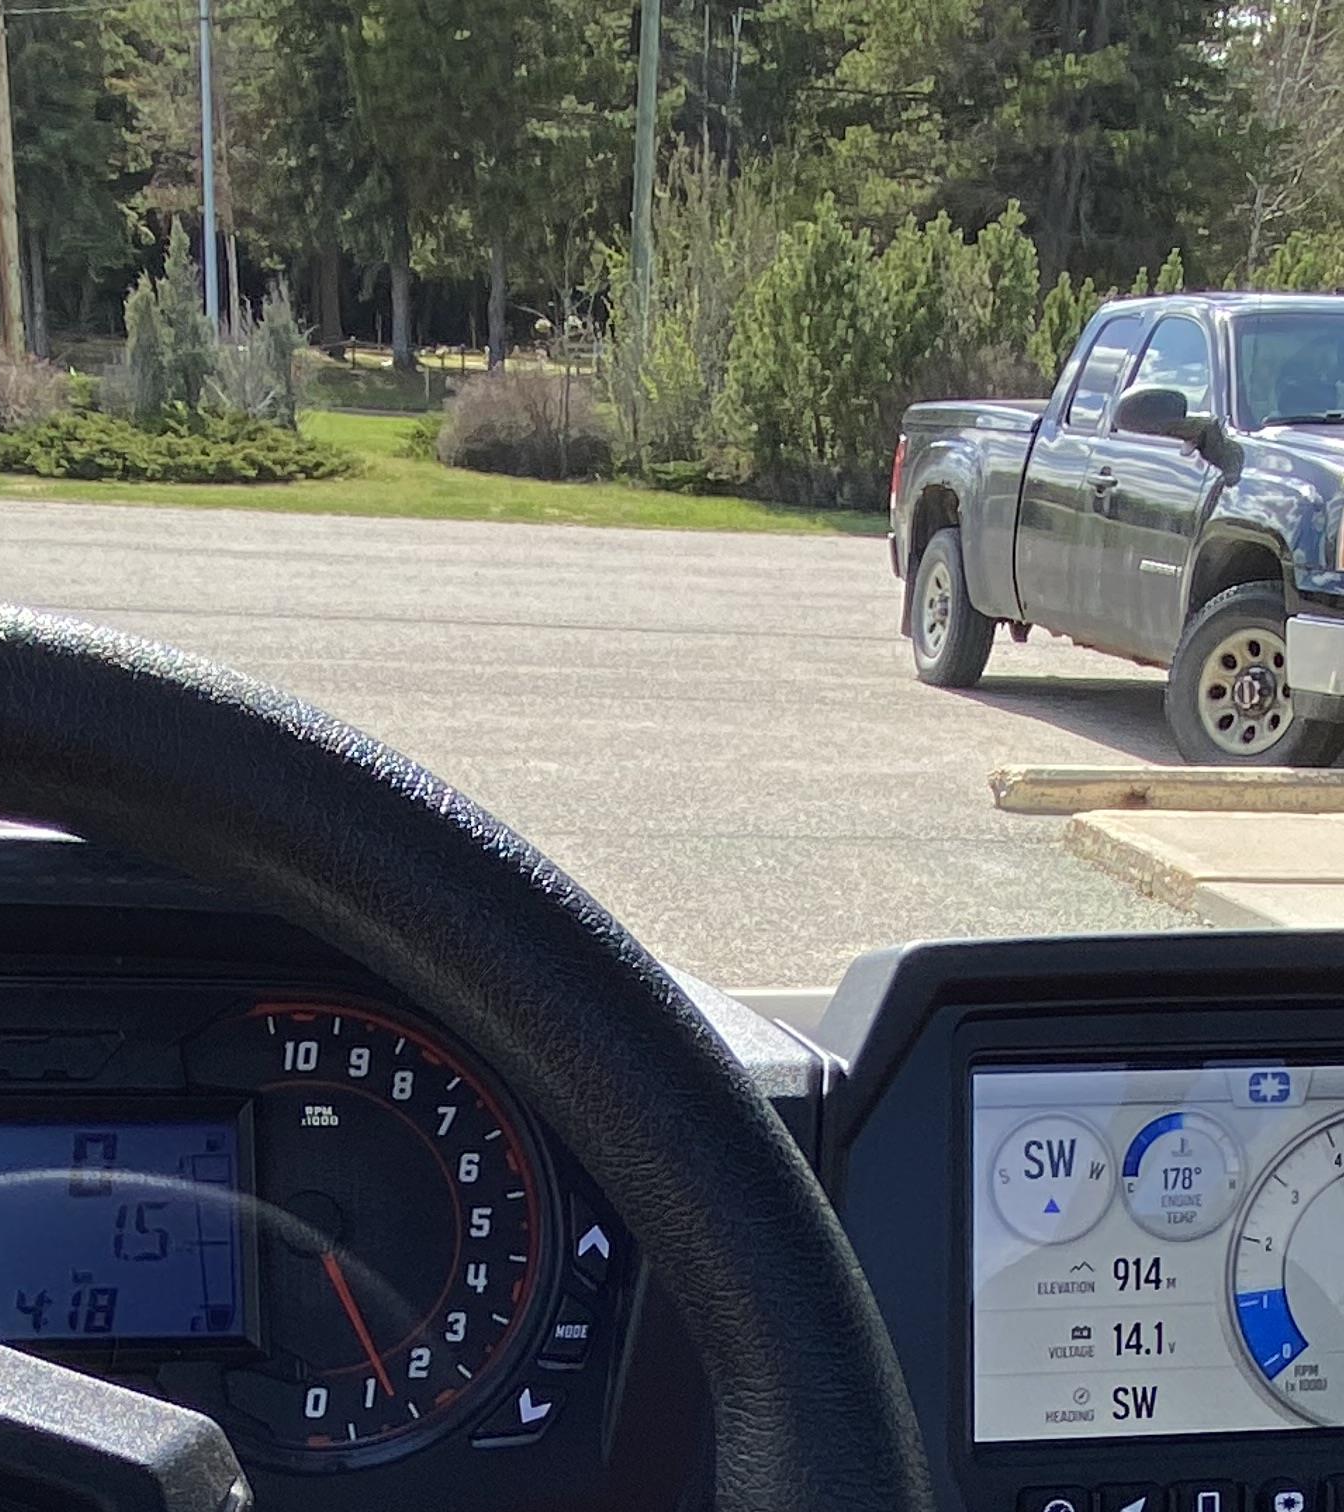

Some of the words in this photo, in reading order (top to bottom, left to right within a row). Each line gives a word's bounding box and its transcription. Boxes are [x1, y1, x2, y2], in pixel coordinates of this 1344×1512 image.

[284, 1041, 318, 1072] 10
[348, 1047, 370, 1078] 9
[392, 1070, 413, 1101] 8
[304, 1106, 333, 1115] RPM
[437, 1106, 457, 1136] 7
[69, 1132, 117, 1197] 0
[458, 1153, 480, 1183] 6
[1024, 1138, 1077, 1180] SW
[1088, 1161, 1106, 1181] W
[1334, 1153, 1344, 1168] 4
[999, 1169, 1010, 1185] S
[1162, 1166, 1202, 1190] 178°
[1291, 1189, 1301, 1204] 3
[469, 1207, 492, 1238] 5
[1166, 1211, 1197, 1224] TEMP
[1265, 1237, 1273, 1253] 2
[466, 1263, 488, 1293] 4
[1038, 1281, 1095, 1295] ELEVATION
[1112, 1257, 1162, 1291] 914
[444, 1311, 466, 1342] 3
[555, 1323, 589, 1340] MODE
[1112, 1322, 1163, 1356] 14.1
[408, 1347, 431, 1378] 2
[1048, 1345, 1095, 1360] VOLTAGE
[1282, 1344, 1292, 1359] 0
[1293, 1365, 1319, 1377] RPM
[305, 1387, 327, 1418] 0
[363, 1377, 377, 1408] 1
[1112, 1386, 1158, 1420] SW
[1045, 1409, 1095, 1424] HEADING
